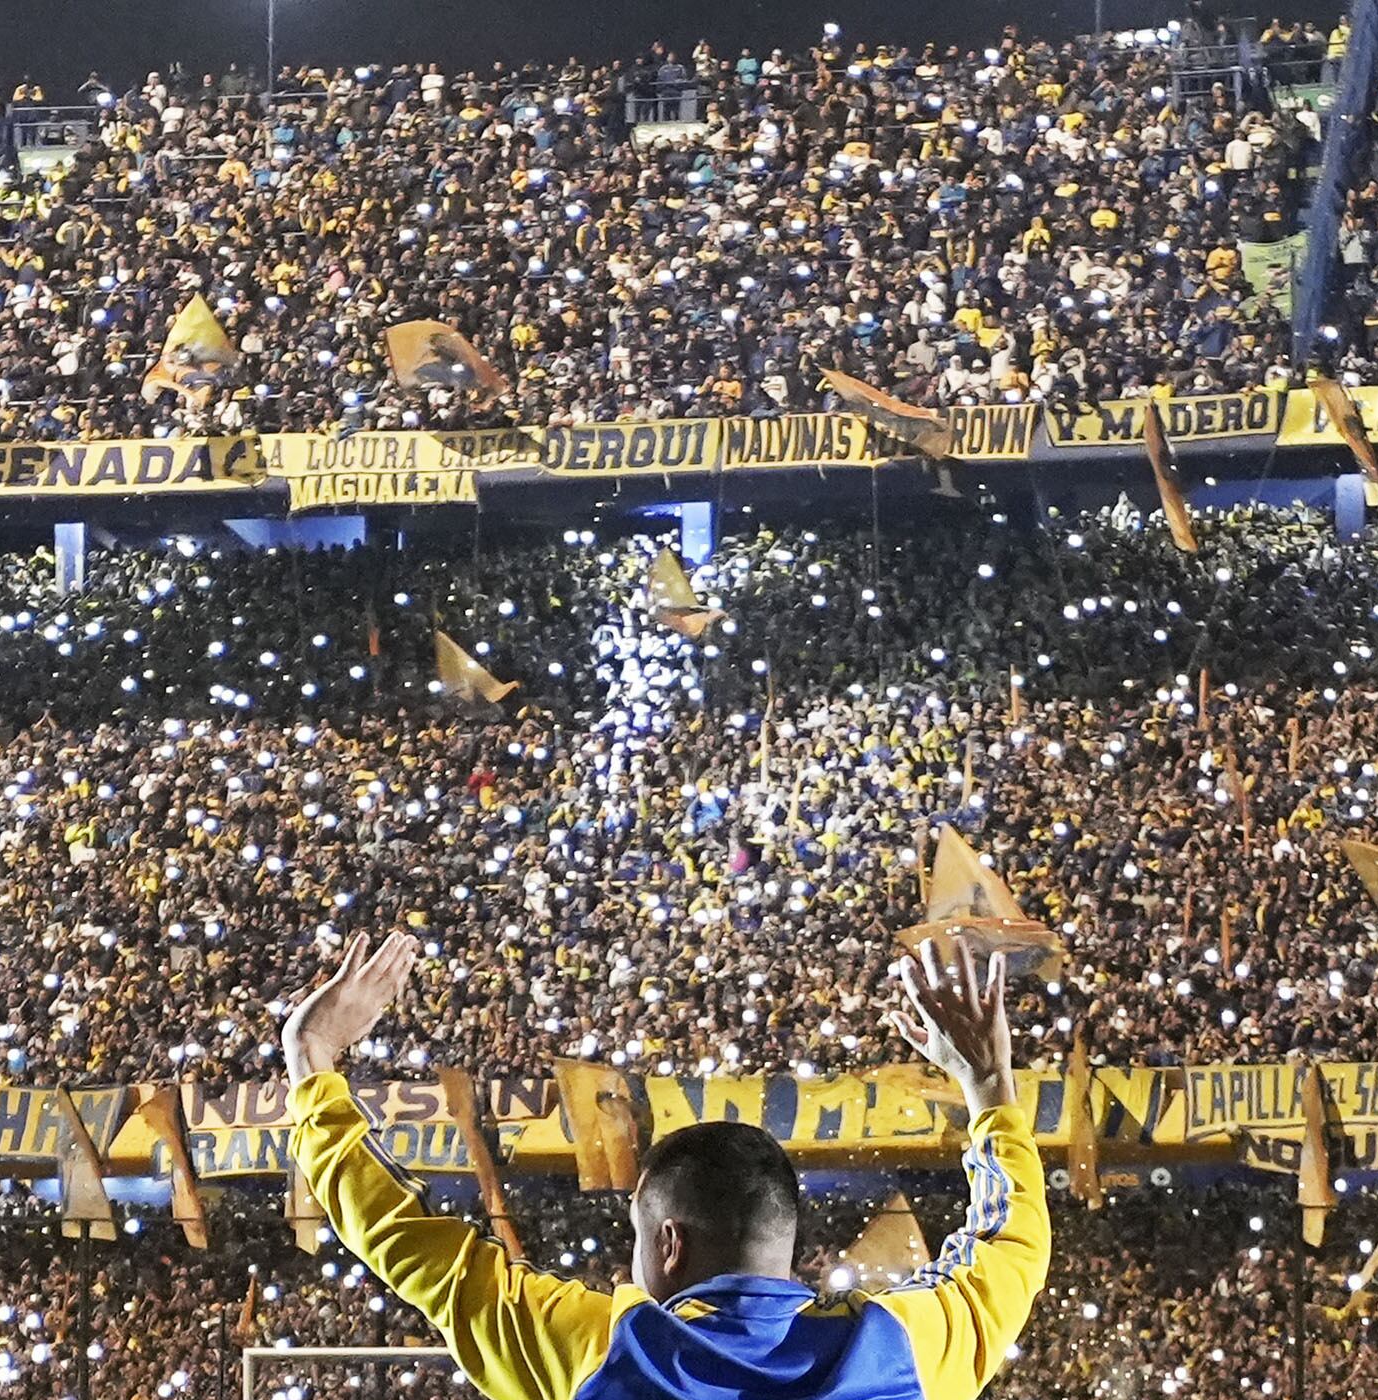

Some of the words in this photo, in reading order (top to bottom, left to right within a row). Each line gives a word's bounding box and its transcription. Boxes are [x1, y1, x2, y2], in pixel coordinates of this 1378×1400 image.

[306, 436, 418, 471] LOCURA
[542, 421, 709, 469] DERQUI
[724, 415, 851, 465] MALVINAS
[951, 407, 1027, 454] ROWN
[290, 471, 478, 510] MAGDALENA
